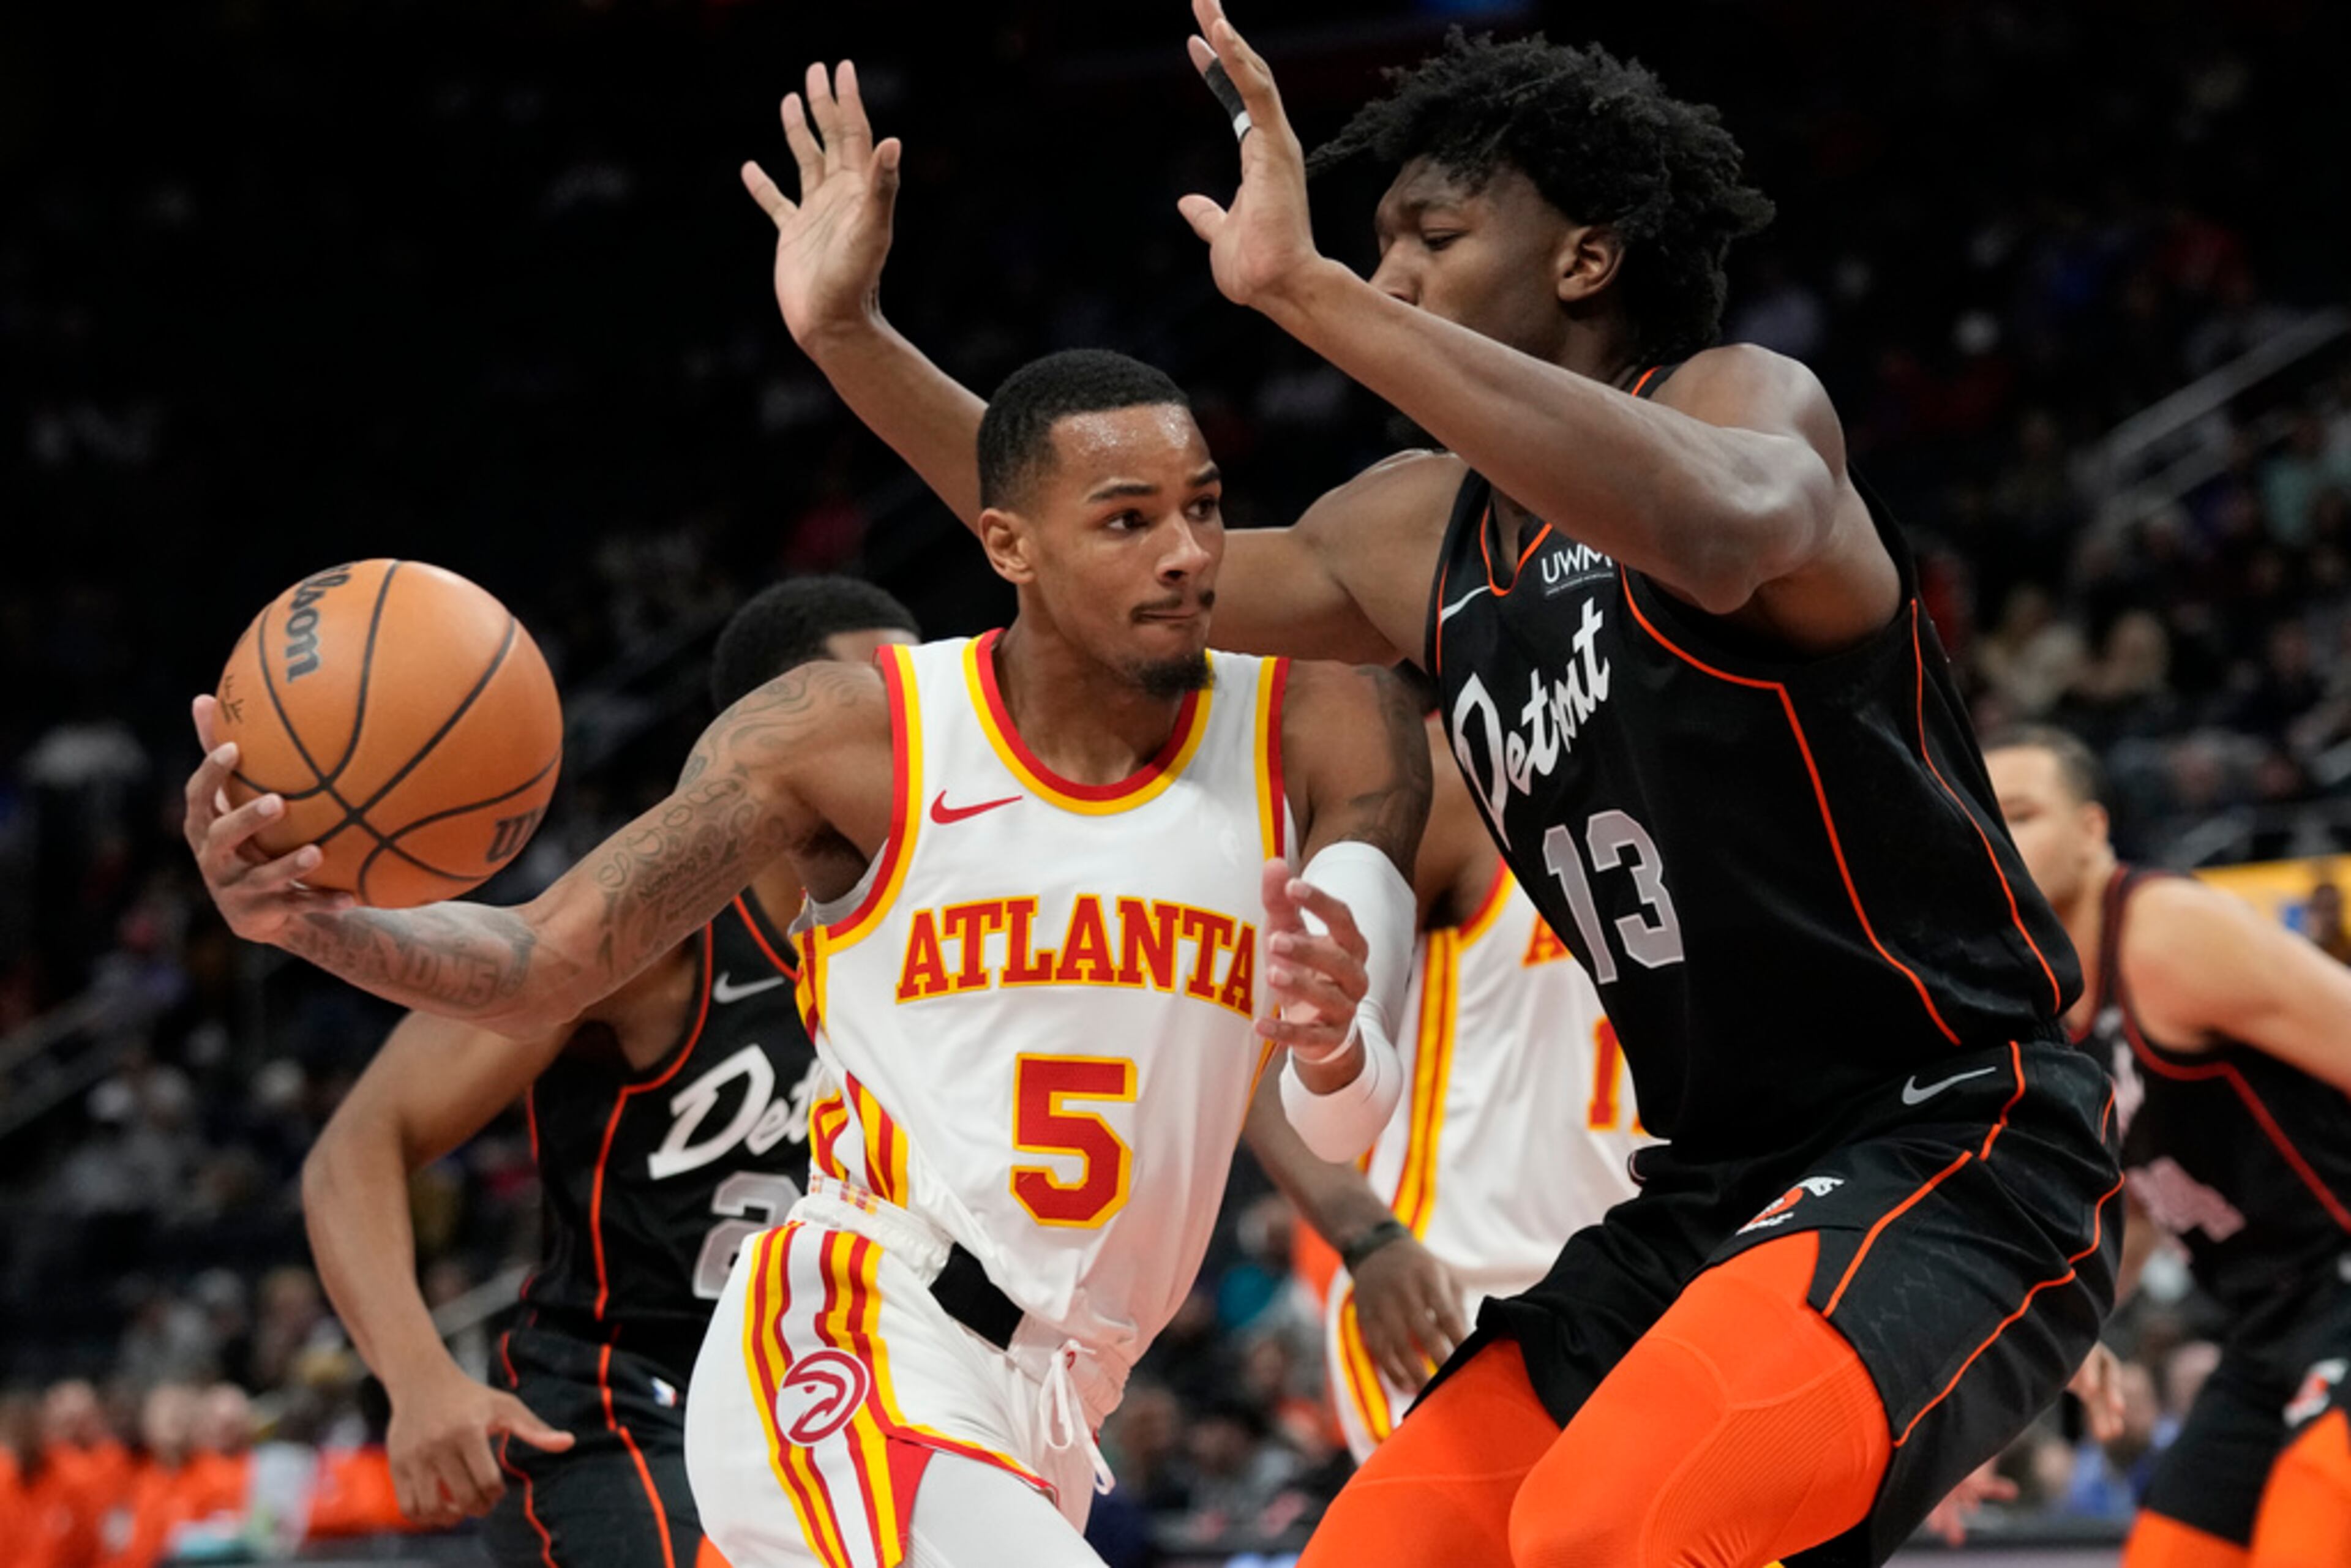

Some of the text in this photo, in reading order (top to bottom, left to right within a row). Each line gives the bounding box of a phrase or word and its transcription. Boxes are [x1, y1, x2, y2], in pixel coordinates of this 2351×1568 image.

[1541, 542, 1613, 583] UWM
[1453, 597, 1610, 852] Detroit
[895, 893, 1256, 1021] ATLANTA
[1542, 809, 1684, 985] 13
[1010, 1051, 1138, 1229] 5
